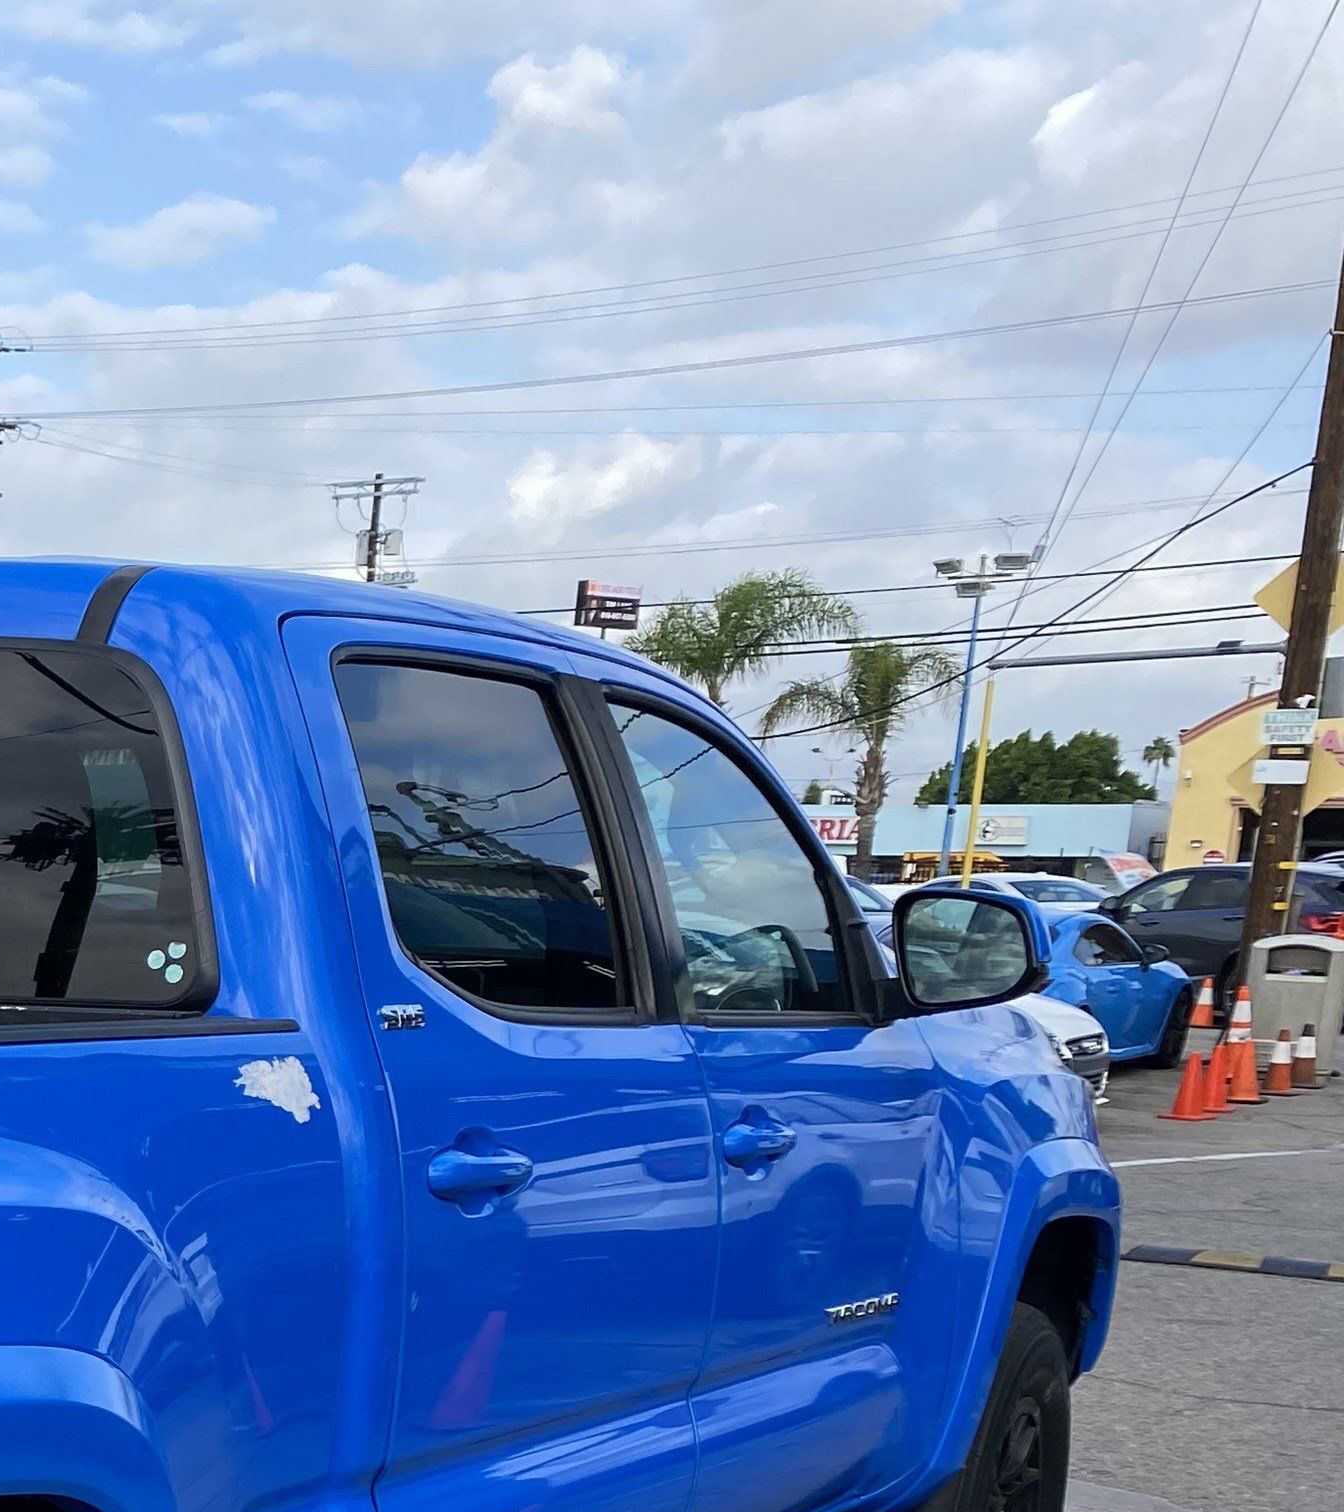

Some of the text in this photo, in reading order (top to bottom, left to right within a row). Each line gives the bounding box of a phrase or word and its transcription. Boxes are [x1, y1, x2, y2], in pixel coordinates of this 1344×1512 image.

[1265, 725, 1312, 734] SAFETY
[1270, 734, 1305, 742] FIRST
[823, 1292, 899, 1321] TACOMA
